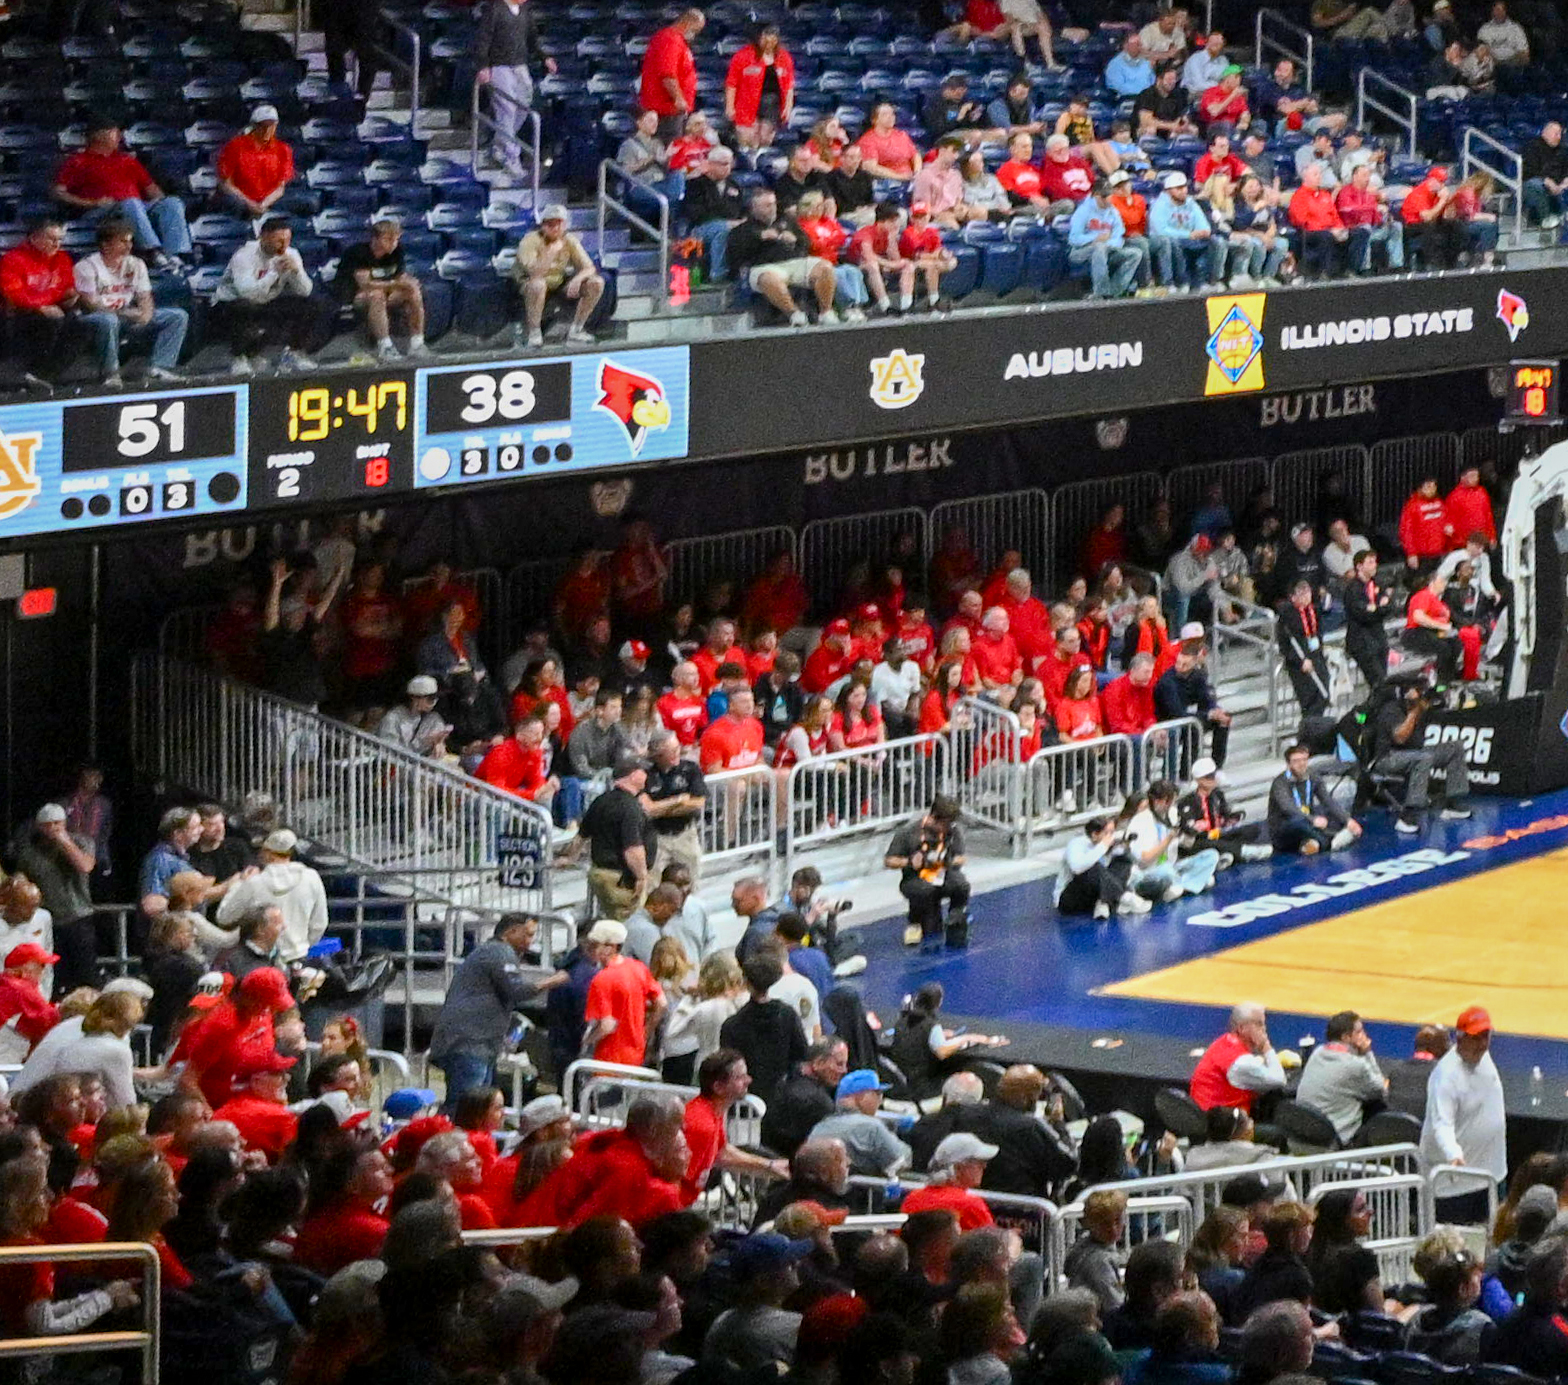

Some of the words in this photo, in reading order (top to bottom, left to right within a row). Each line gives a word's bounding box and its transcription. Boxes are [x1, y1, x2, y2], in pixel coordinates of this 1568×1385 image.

[1219, 336, 1251, 350] NIT
[1281, 317, 1391, 350] ILLINOIS
[1394, 308, 1473, 338] STATE
[1004, 342, 1142, 380] AUBURN
[288, 381, 406, 442] 19:47
[461, 371, 536, 423] 38
[1260, 385, 1376, 427] BUTLER
[118, 401, 185, 457] 51
[464, 451, 482, 474] 3
[502, 446, 520, 470] 0
[803, 439, 952, 484] BUTLER
[126, 487, 148, 513] 0
[167, 483, 187, 509] 3
[277, 468, 300, 497] 2
[503, 854, 534, 887] 123
[1187, 848, 1472, 927] COLLEGE
